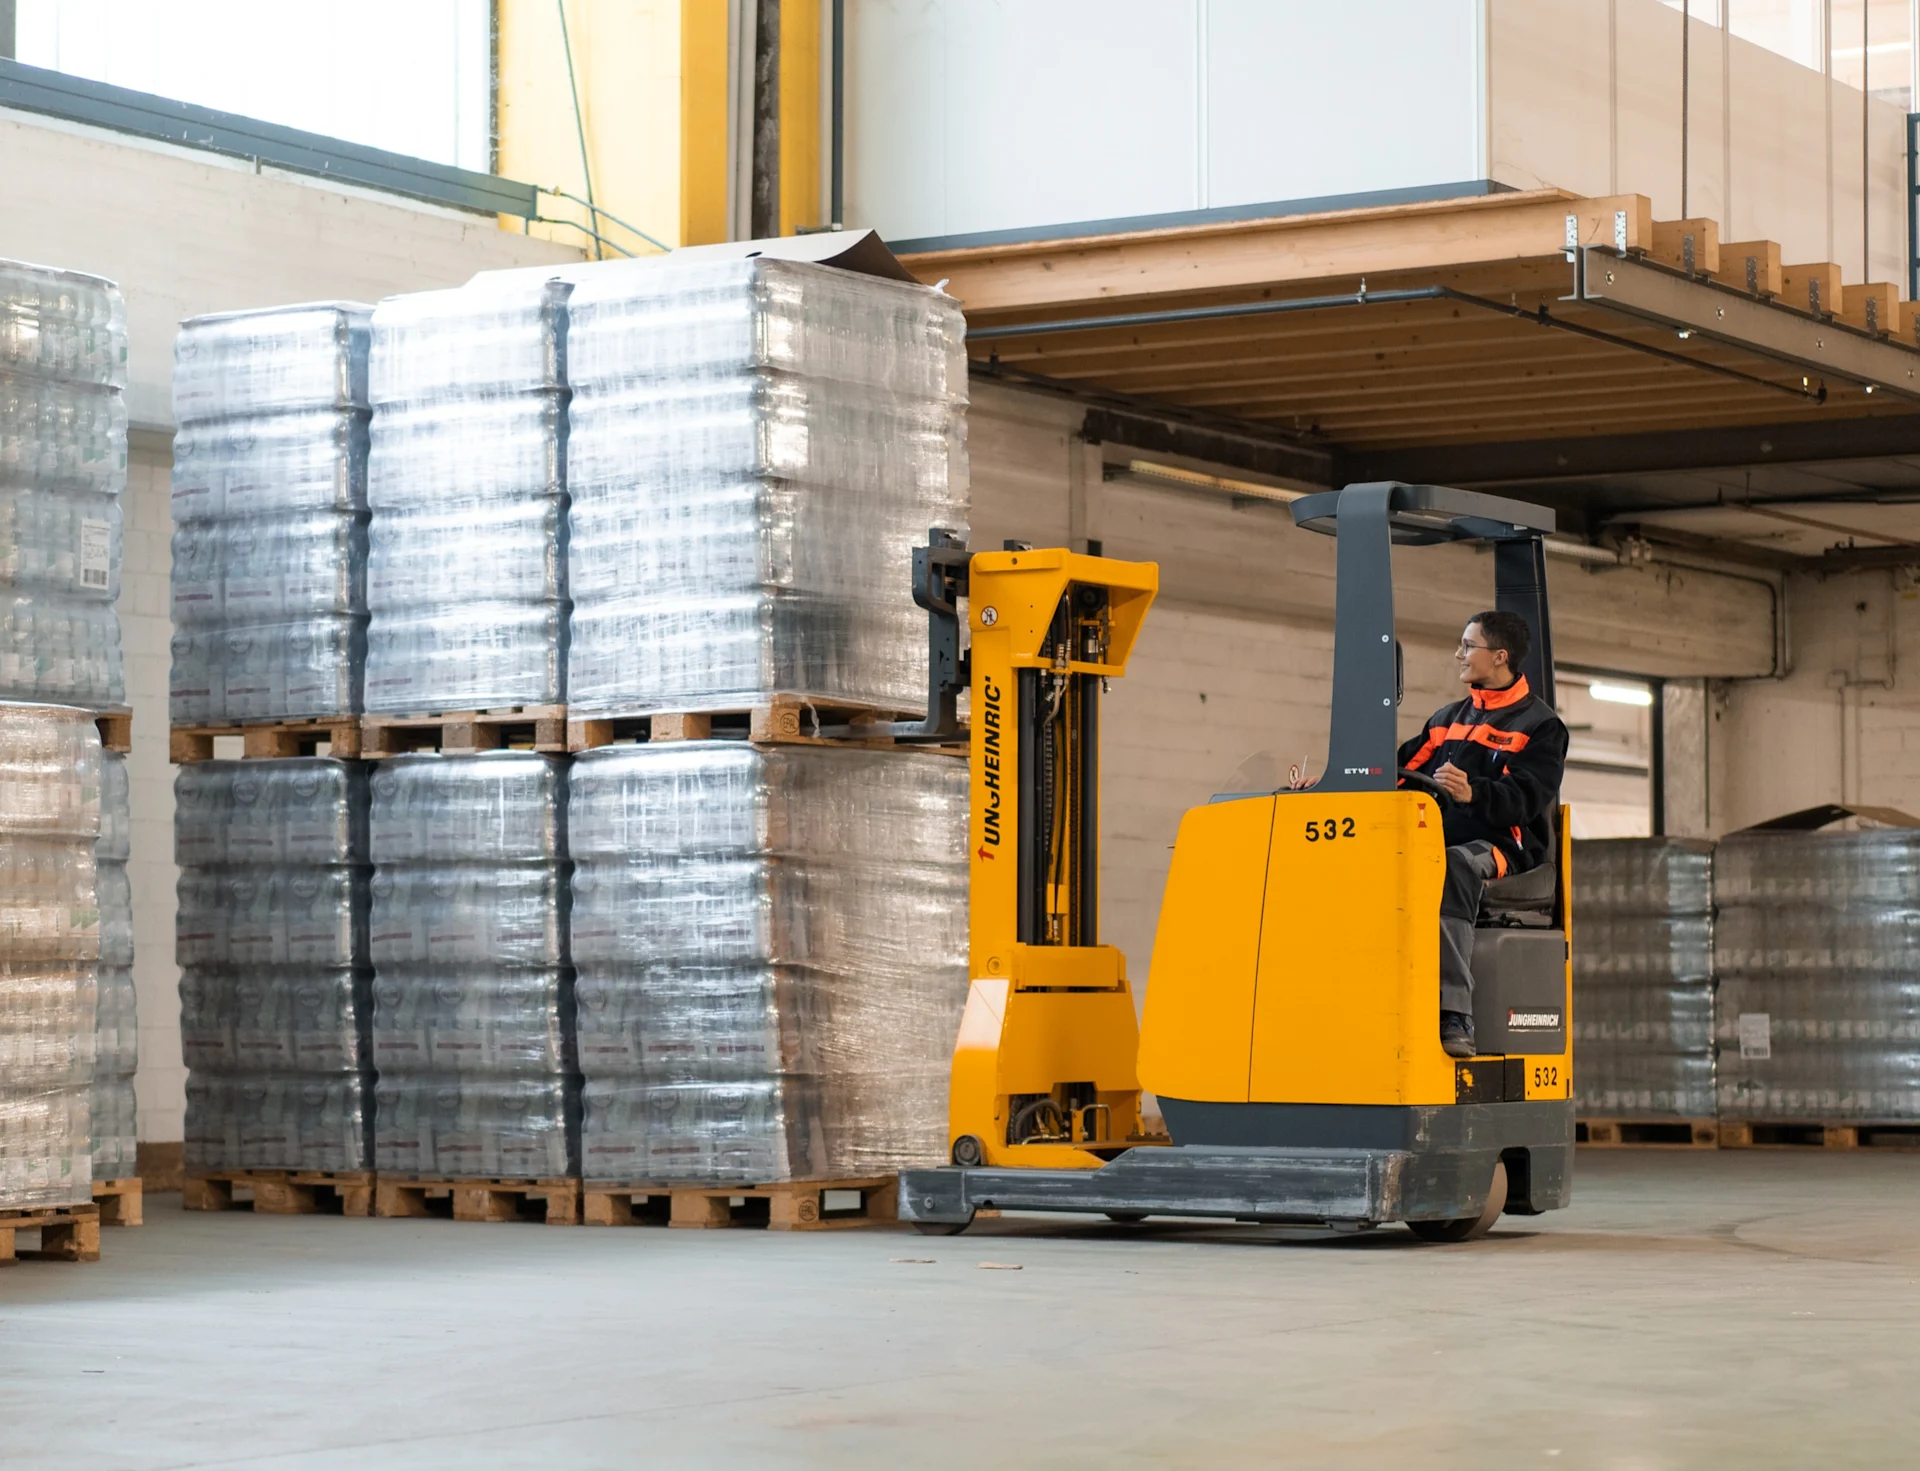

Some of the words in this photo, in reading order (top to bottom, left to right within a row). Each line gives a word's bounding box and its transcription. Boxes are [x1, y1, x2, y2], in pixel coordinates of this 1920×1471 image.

[981, 675, 1001, 862] UNGHEINRIC
[1305, 817, 1356, 842] 532
[1508, 1011, 1559, 1026] JUNGHEINRICH
[1534, 1066, 1558, 1088] 532
